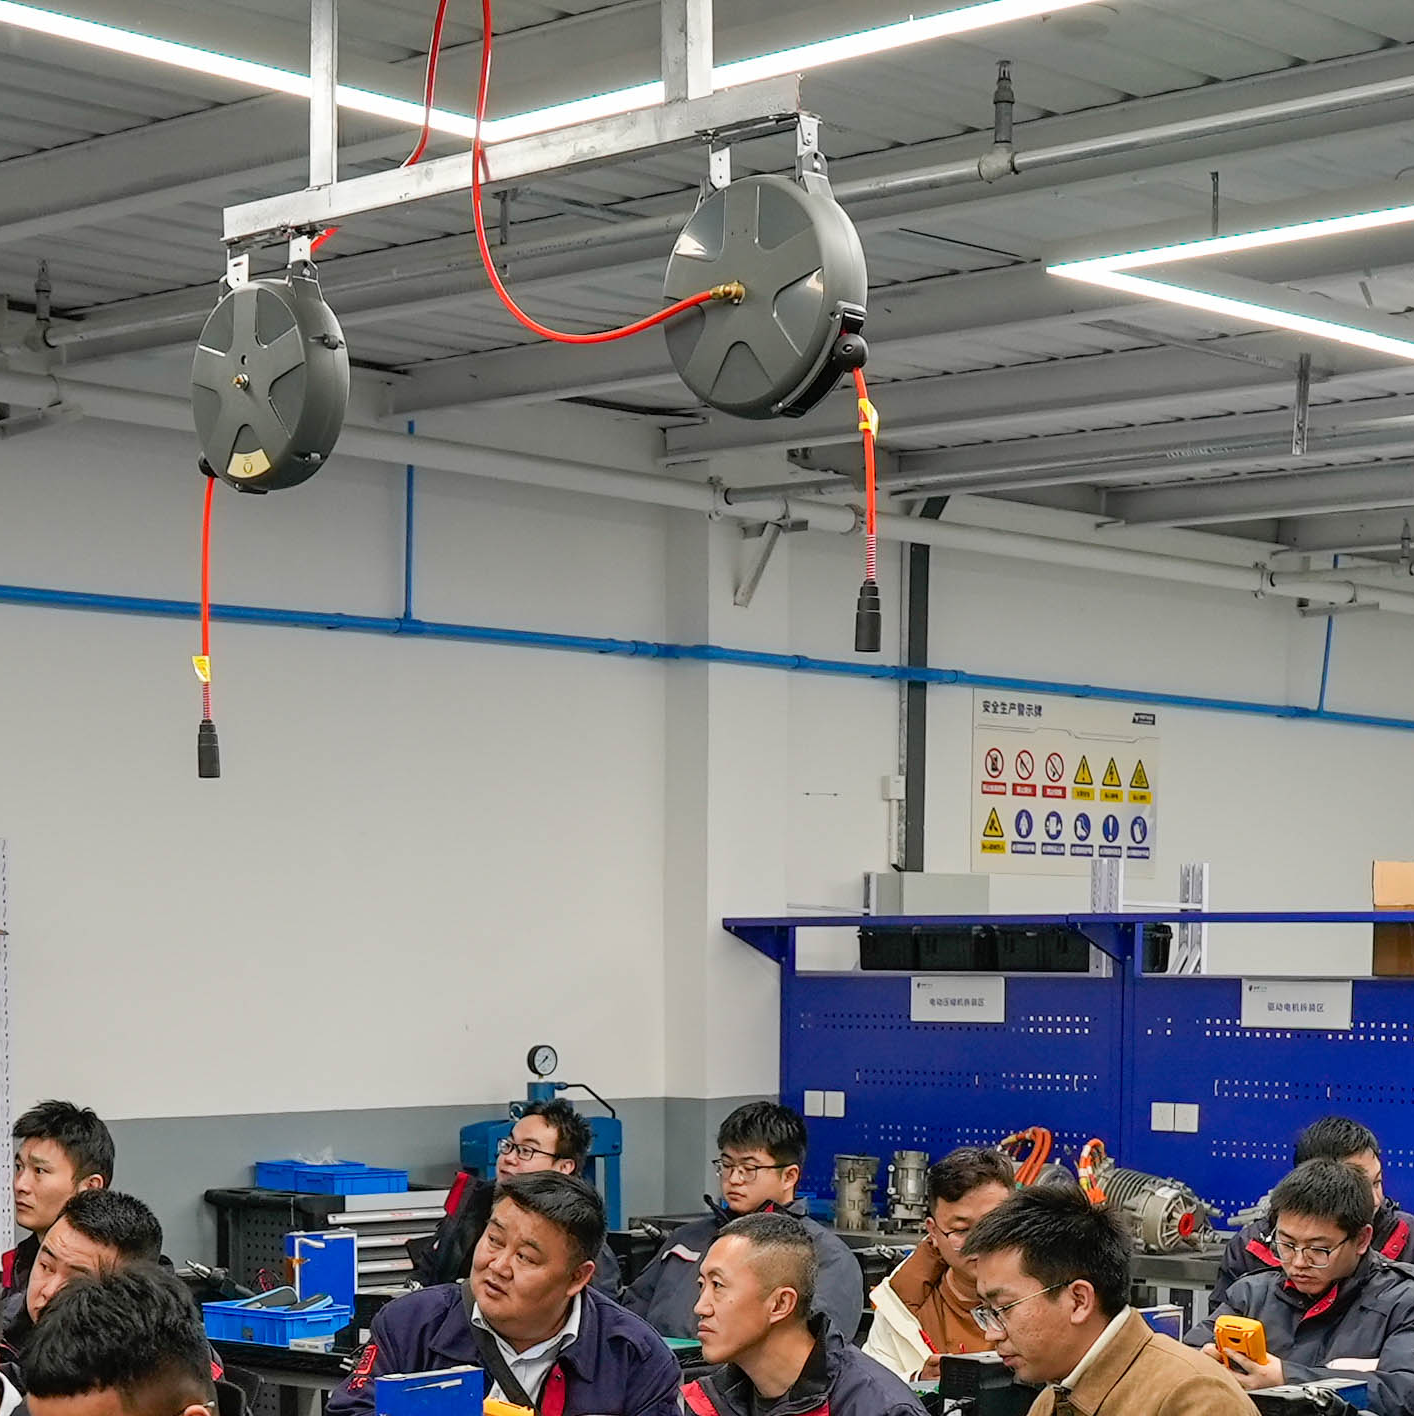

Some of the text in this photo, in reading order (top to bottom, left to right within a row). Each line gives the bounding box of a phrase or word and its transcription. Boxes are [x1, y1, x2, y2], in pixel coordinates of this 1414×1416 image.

[982, 700, 1043, 718] 安全生产警示牌
[1267, 1002, 1324, 1012] 驱动电机拆装区
